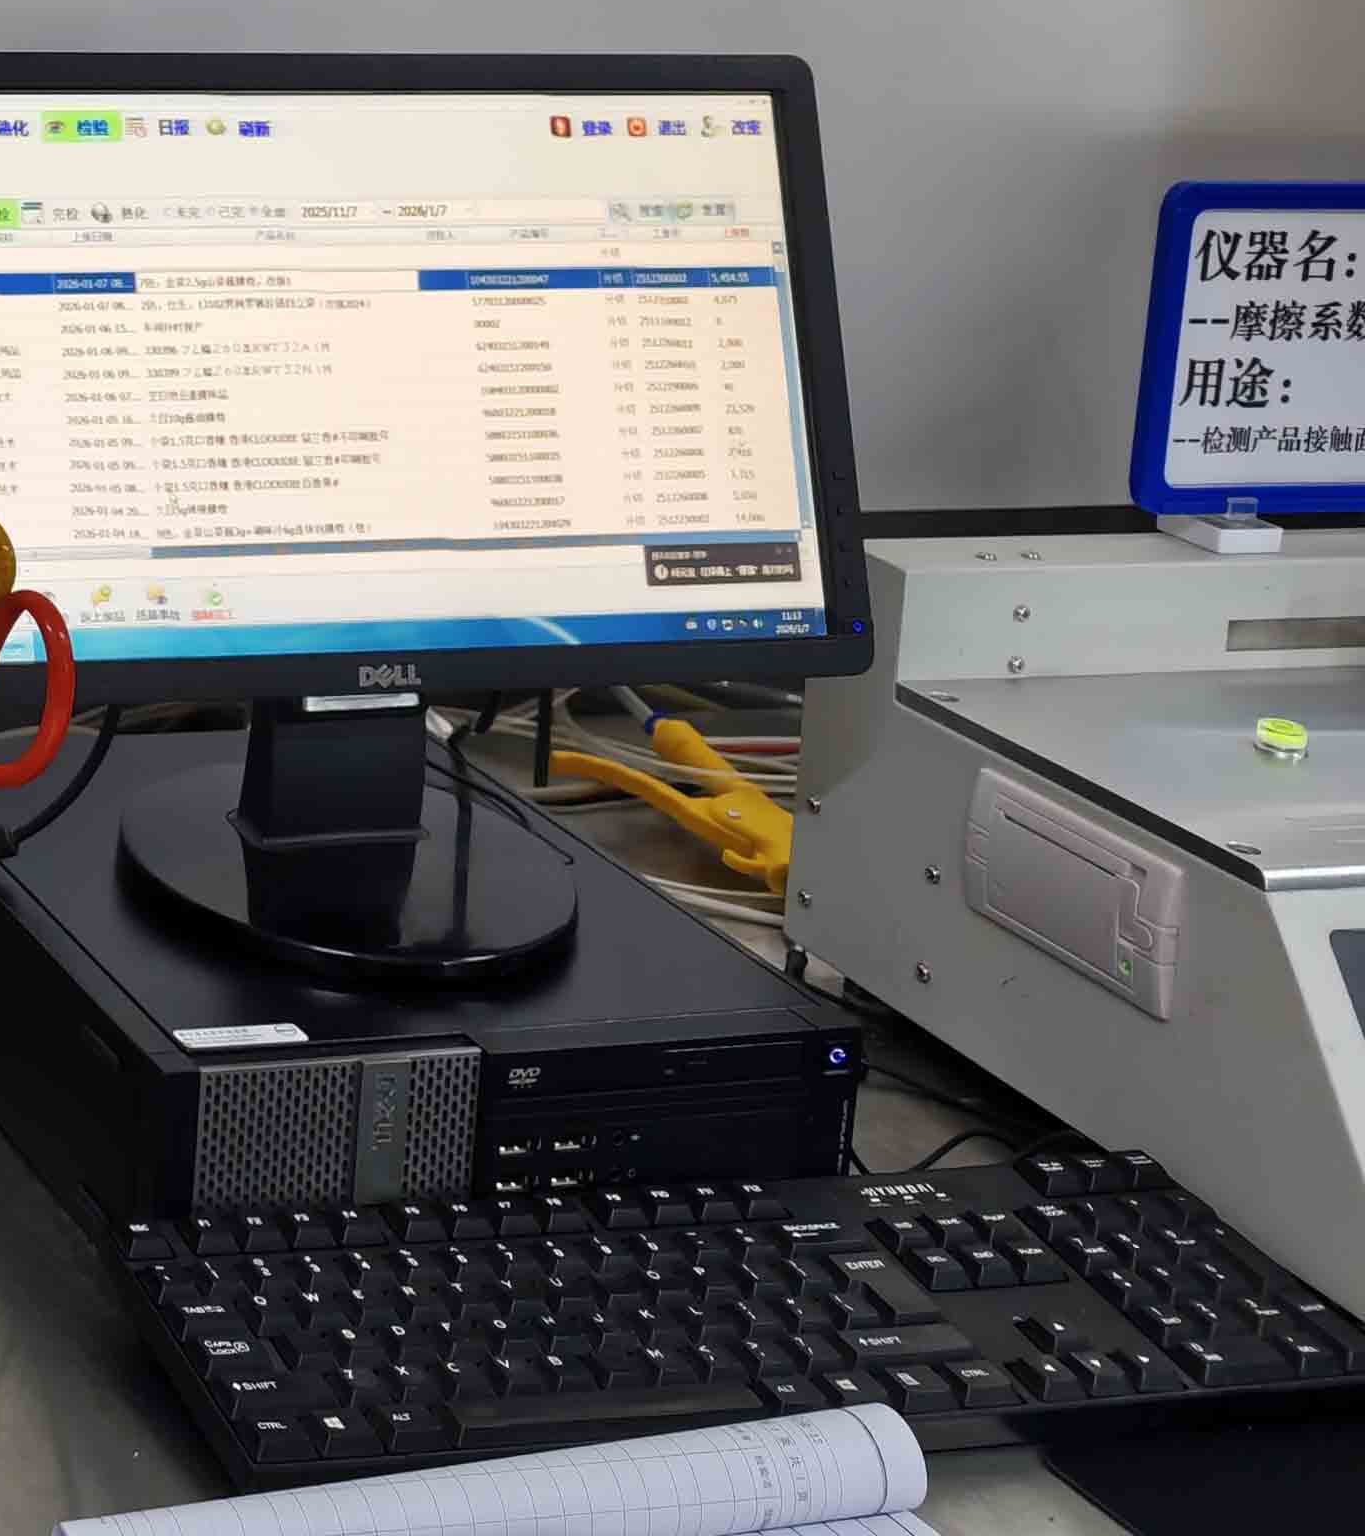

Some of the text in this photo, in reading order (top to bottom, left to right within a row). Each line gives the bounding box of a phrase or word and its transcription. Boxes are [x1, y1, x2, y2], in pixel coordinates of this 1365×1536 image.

[76, 120, 109, 136] 检验
[159, 119, 190, 136] 日报
[1195, 229, 1357, 282] 仪器名：
[1178, 357, 1291, 408] 用途：
[358, 664, 421, 688] DELL
[508, 1066, 541, 1080] DVD
[867, 1182, 936, 1197] HYUNDAI
[845, 1259, 885, 1269] ENTER
[242, 1381, 277, 1391] SHIFT
[867, 1335, 901, 1345] SHIFT
[257, 1421, 288, 1430] CTRL
[777, 1384, 796, 1392] ALT
